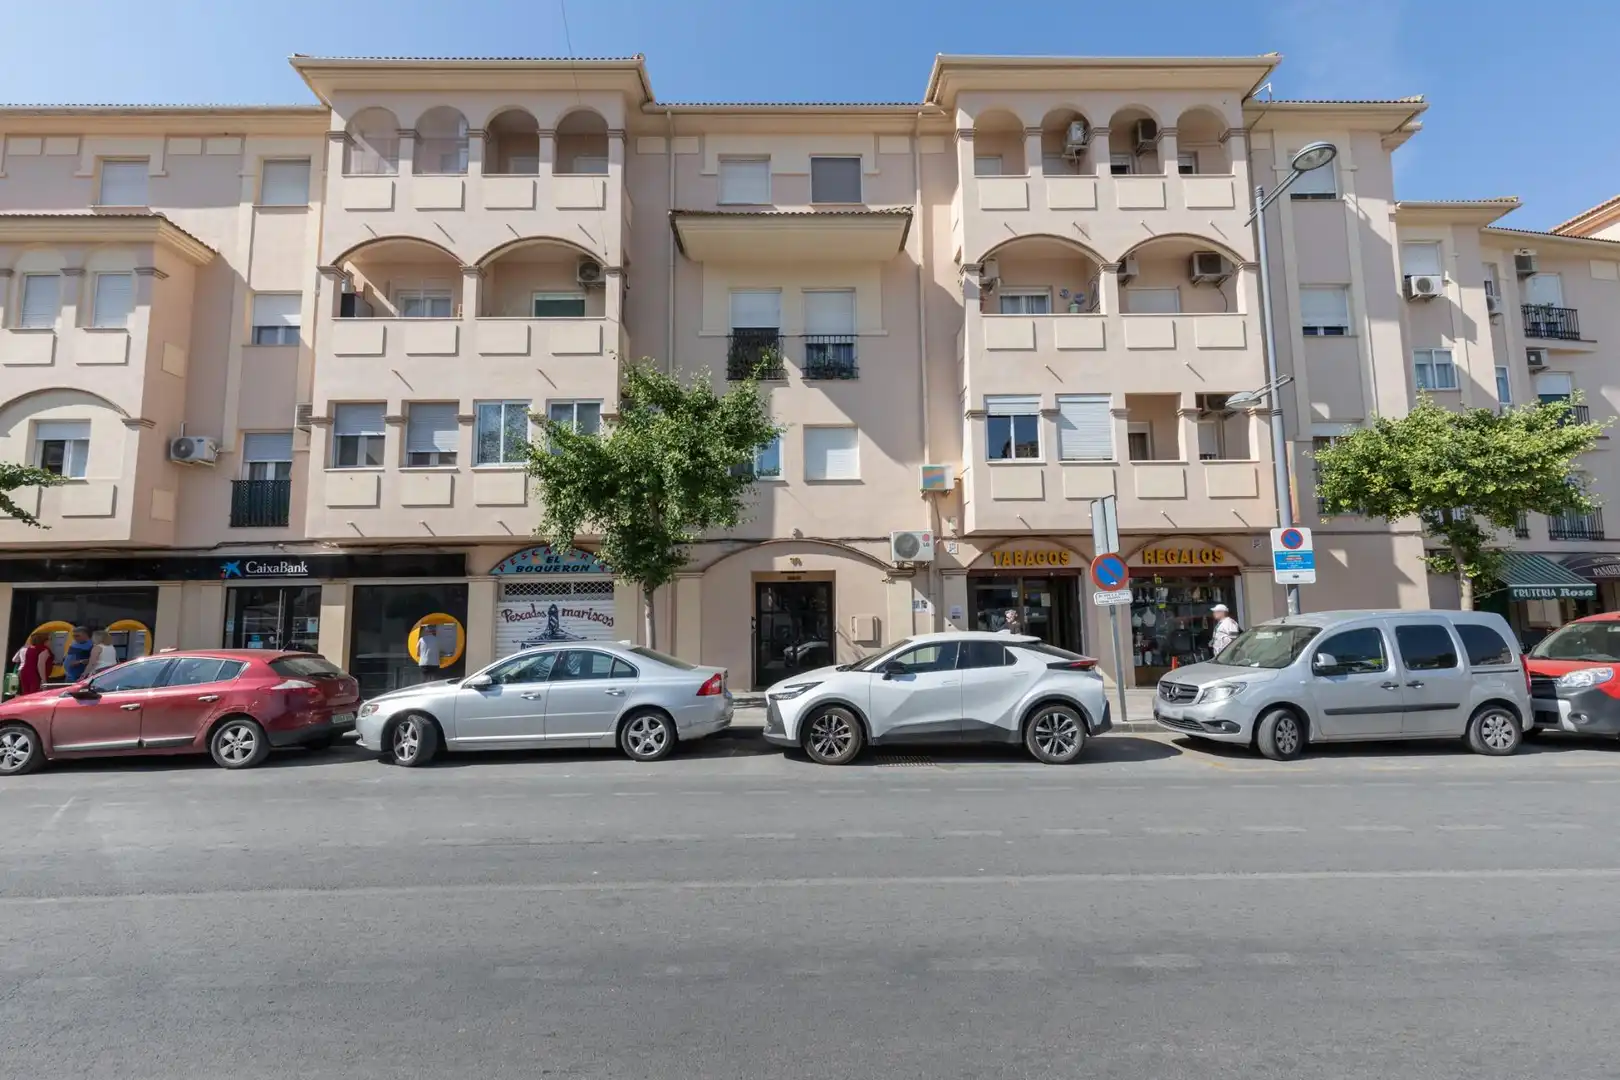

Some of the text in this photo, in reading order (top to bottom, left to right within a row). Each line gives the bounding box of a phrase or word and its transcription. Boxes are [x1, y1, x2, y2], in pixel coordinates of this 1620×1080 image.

[545, 556, 561, 564] EL
[991, 550, 1070, 567] TABACOS
[1142, 548, 1225, 565] REGALOS
[245, 561, 309, 574] CaixaBank
[515, 564, 590, 573] BOQUERON
[1513, 588, 1594, 598] FRUTERIA Rosa
[500, 603, 614, 627] Pescados mariscos
